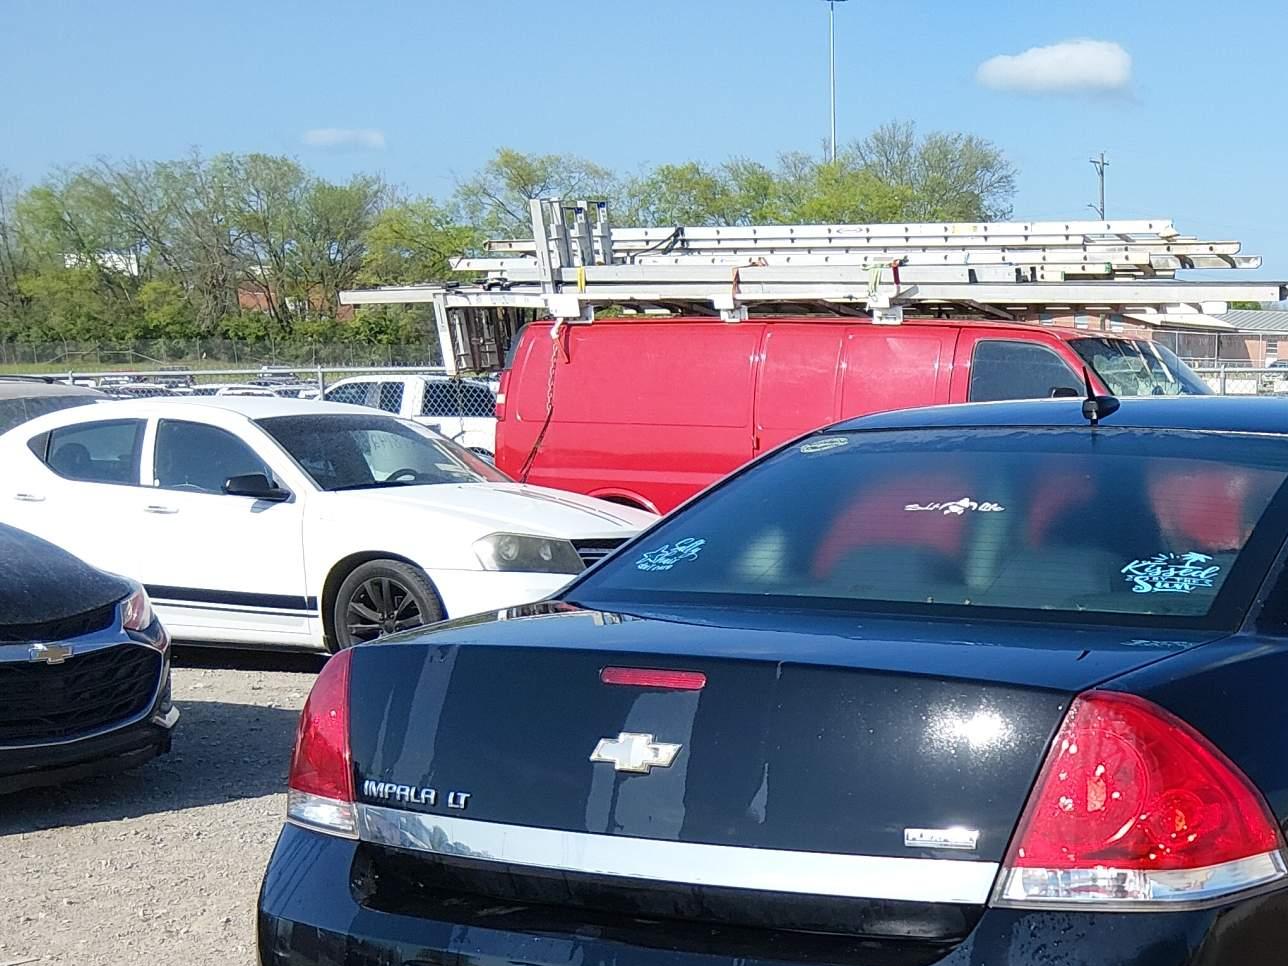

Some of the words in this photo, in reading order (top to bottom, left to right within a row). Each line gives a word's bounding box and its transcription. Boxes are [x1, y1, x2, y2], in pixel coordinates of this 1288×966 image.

[1120, 559, 1220, 579] Kissed
[1132, 576, 1196, 593] Sun
[363, 780, 436, 805] IMPALA
[447, 791, 471, 809] LT
